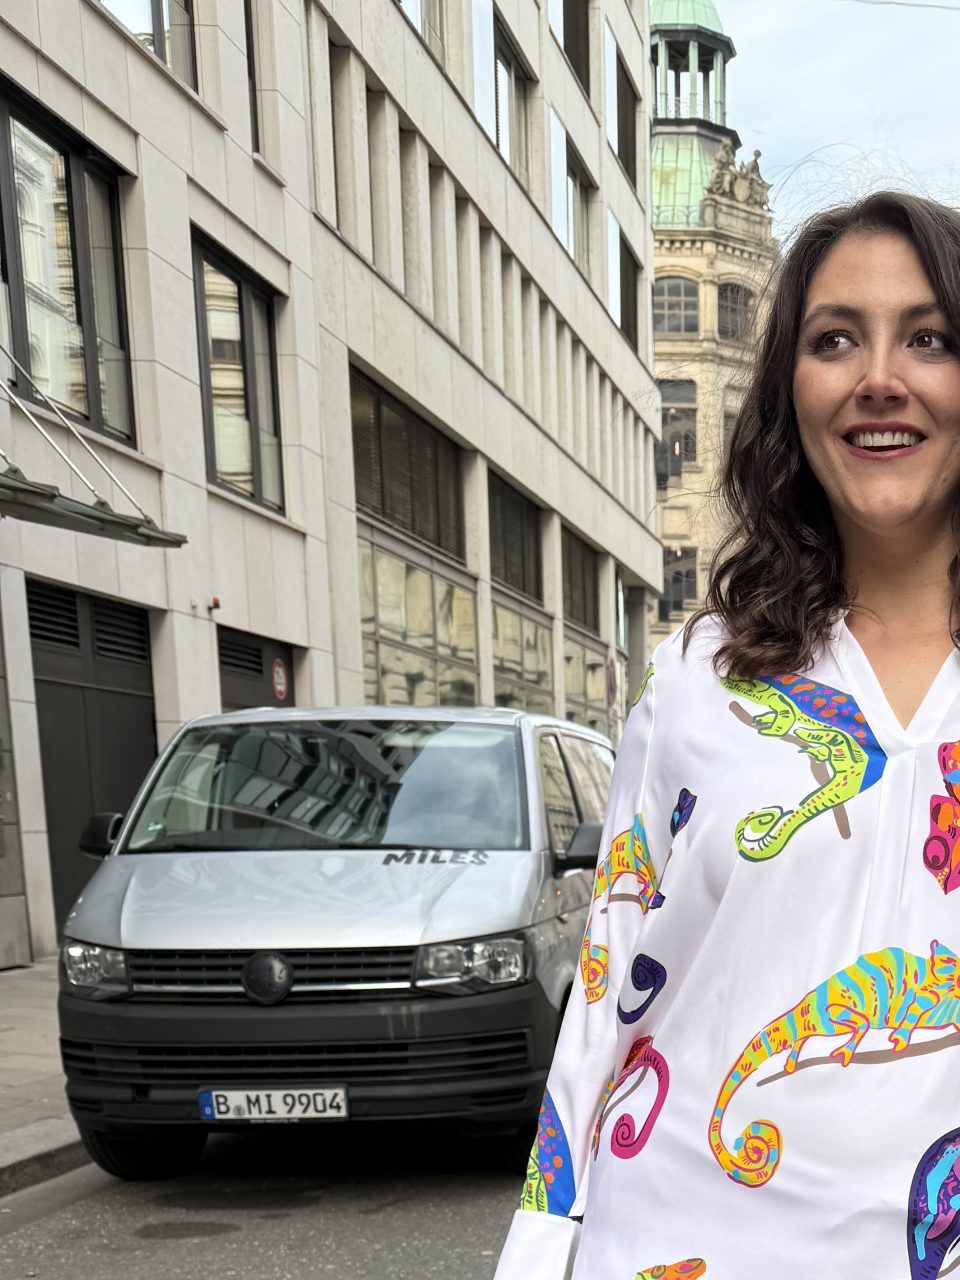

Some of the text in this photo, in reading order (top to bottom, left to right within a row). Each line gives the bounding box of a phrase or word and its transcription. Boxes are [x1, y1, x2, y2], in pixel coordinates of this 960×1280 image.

[382, 850, 490, 865] MILES
[214, 1092, 343, 1115] B MI 9904
